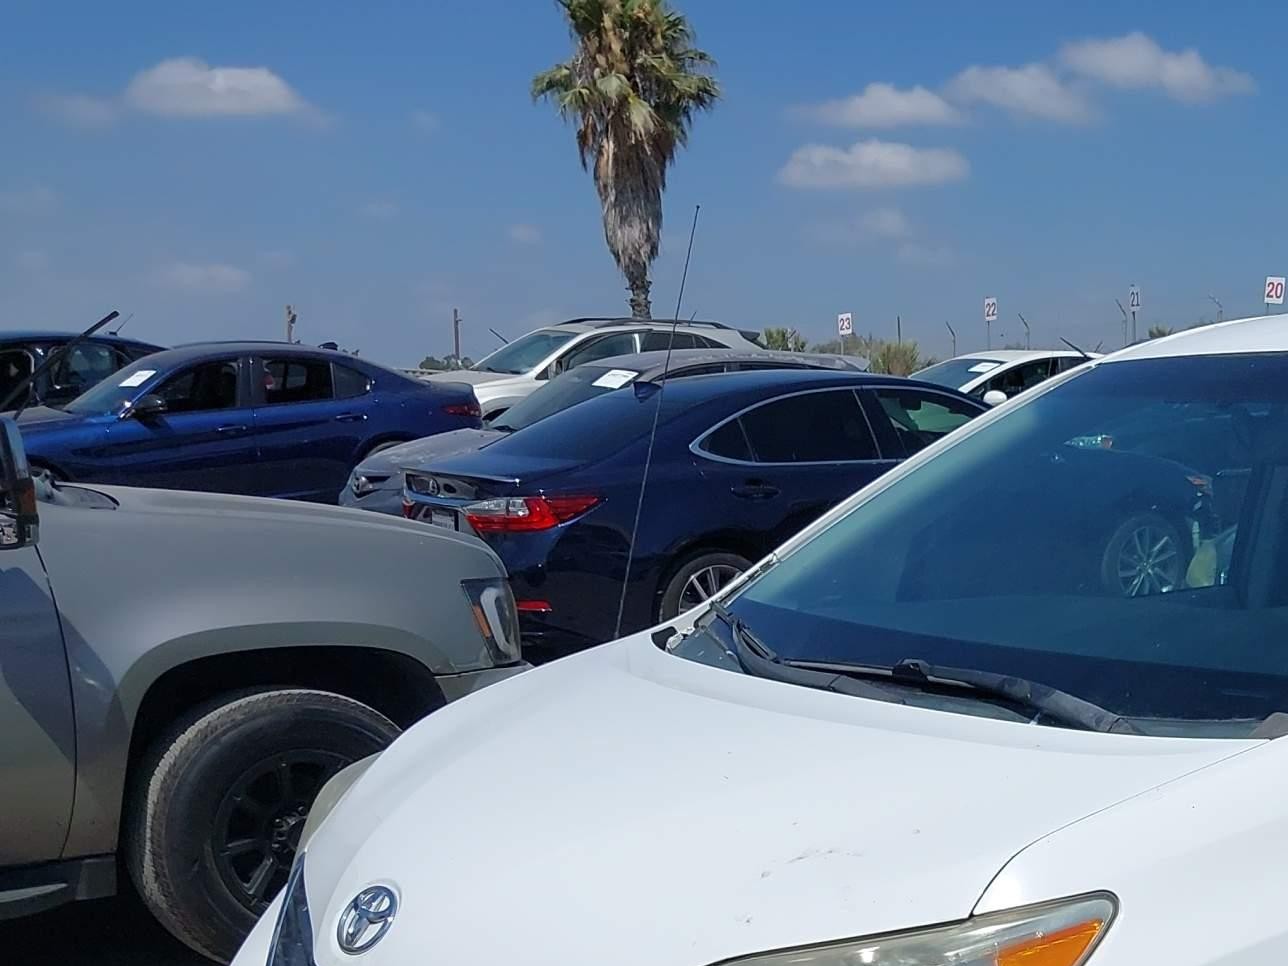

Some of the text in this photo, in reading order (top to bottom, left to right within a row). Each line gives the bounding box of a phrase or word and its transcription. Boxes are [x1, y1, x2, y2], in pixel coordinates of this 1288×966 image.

[1266, 281, 1284, 299] 20
[1130, 291, 1140, 307] 21
[985, 302, 997, 318] 22
[839, 317, 851, 331] 23
